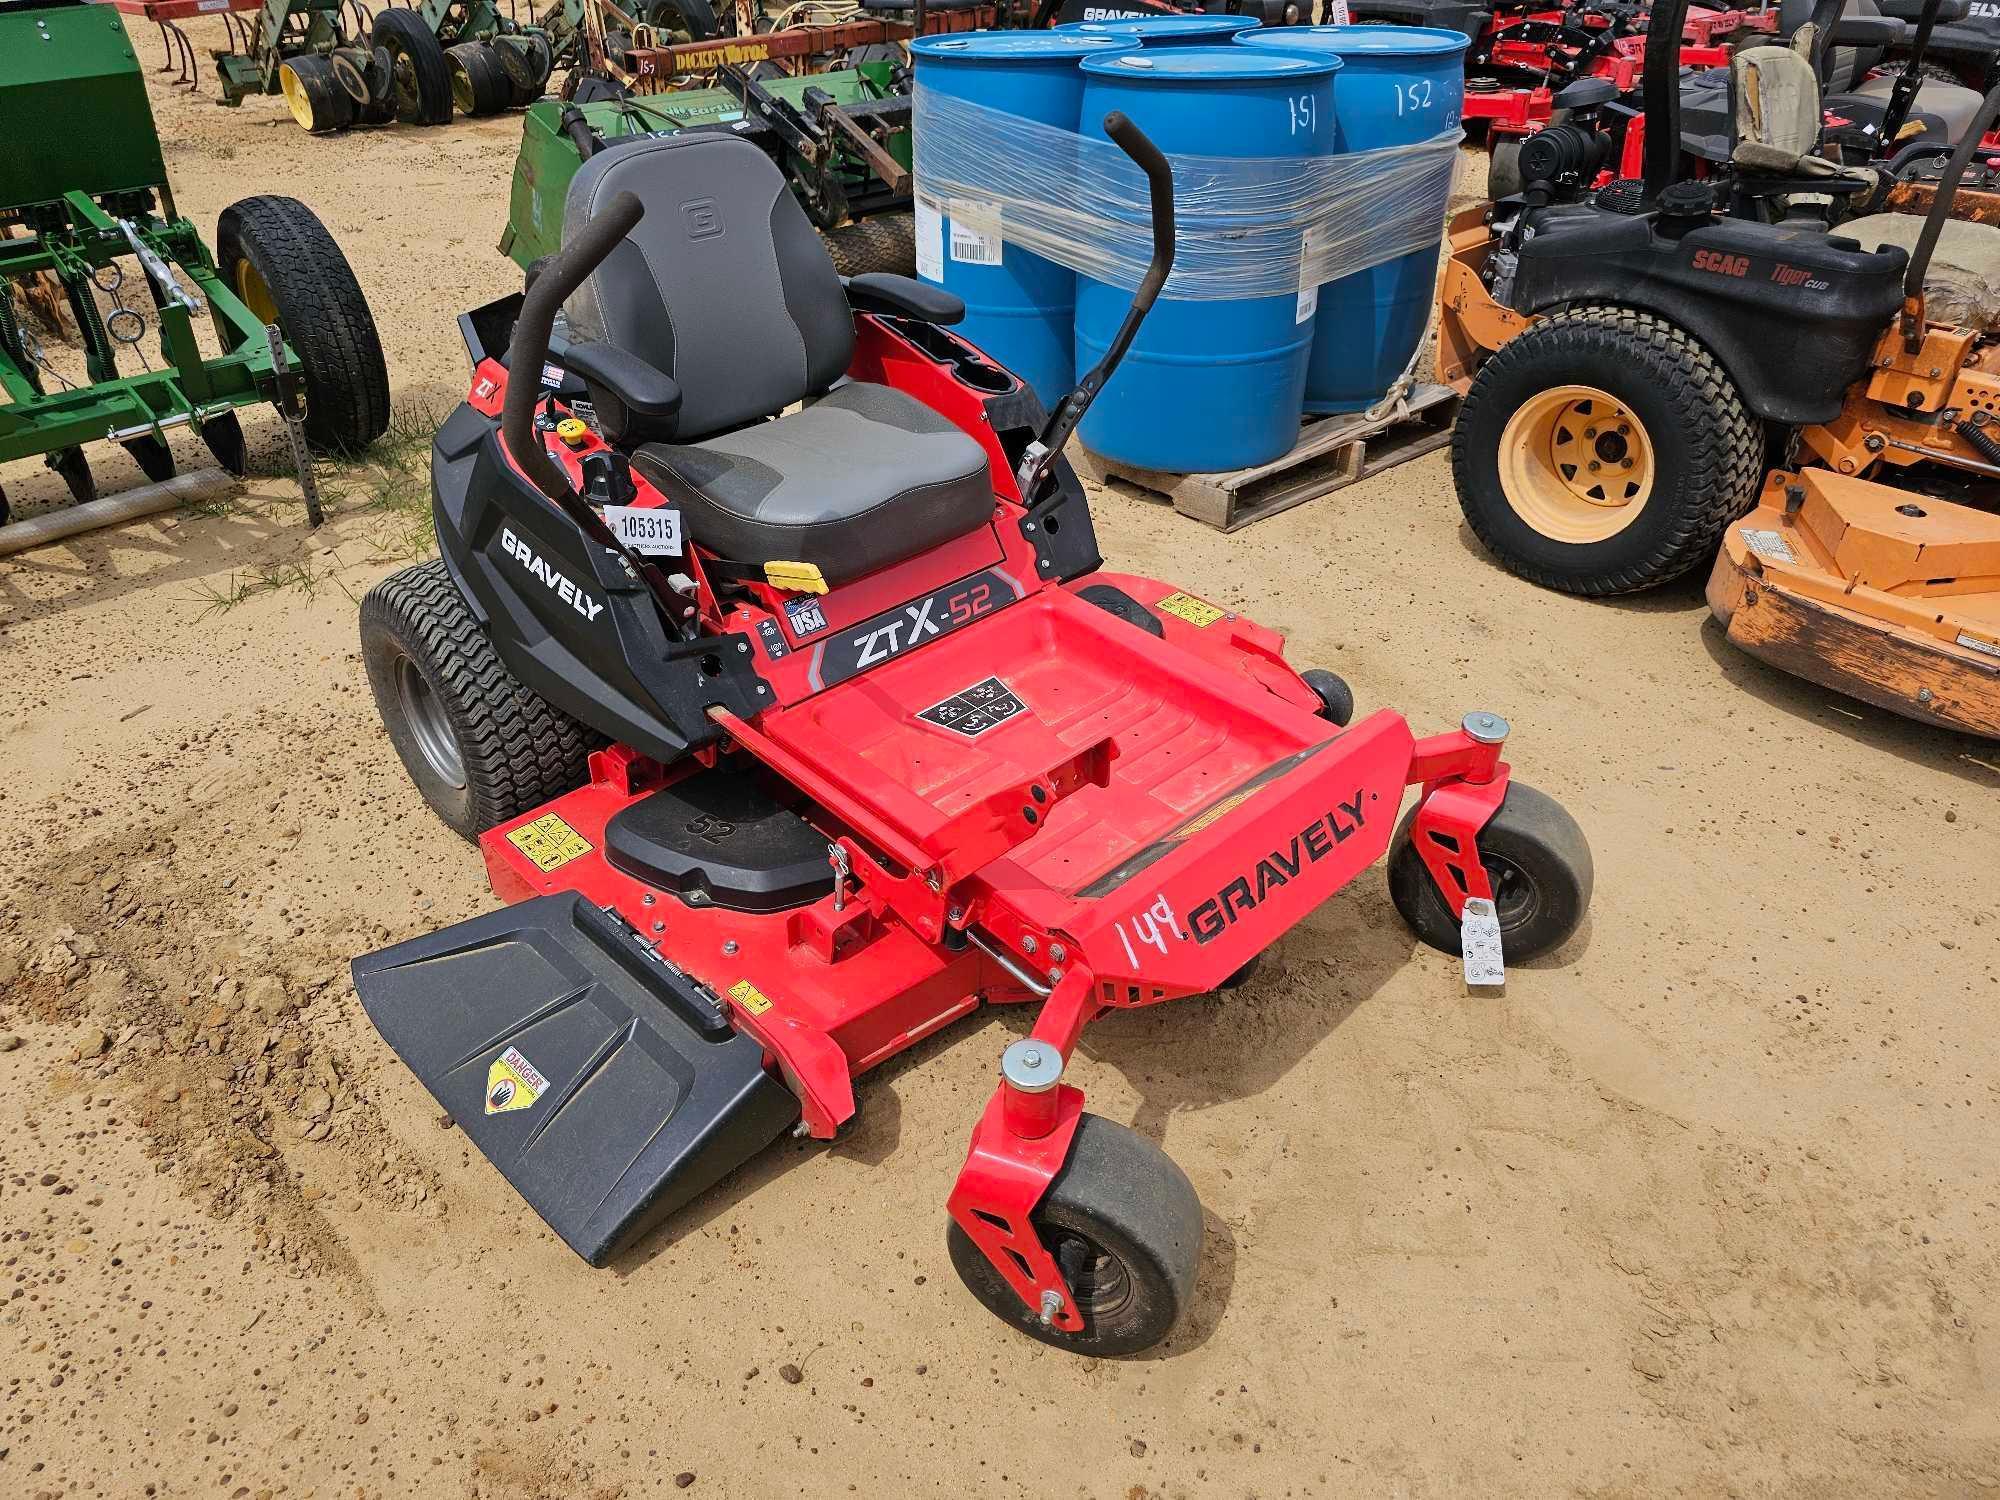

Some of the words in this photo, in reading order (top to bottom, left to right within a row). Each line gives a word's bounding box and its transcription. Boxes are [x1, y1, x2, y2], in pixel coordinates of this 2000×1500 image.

[1084, 8, 1160, 20] GRAVE
[1288, 94, 1316, 136] 151
[1394, 79, 1432, 117] 152
[1692, 250, 1750, 278] SCAG
[1770, 263, 1813, 286] Tiger
[1803, 279, 1830, 291] CUB
[475, 377, 502, 404] ZTX
[621, 515, 673, 540] 105315
[501, 527, 604, 622] GRAVELY
[790, 606, 827, 635] USA
[684, 812, 738, 846] 52
[1187, 788, 1366, 946] GRAVELY
[1114, 893, 1185, 970] 149
[505, 1052, 544, 1091] DANGER
